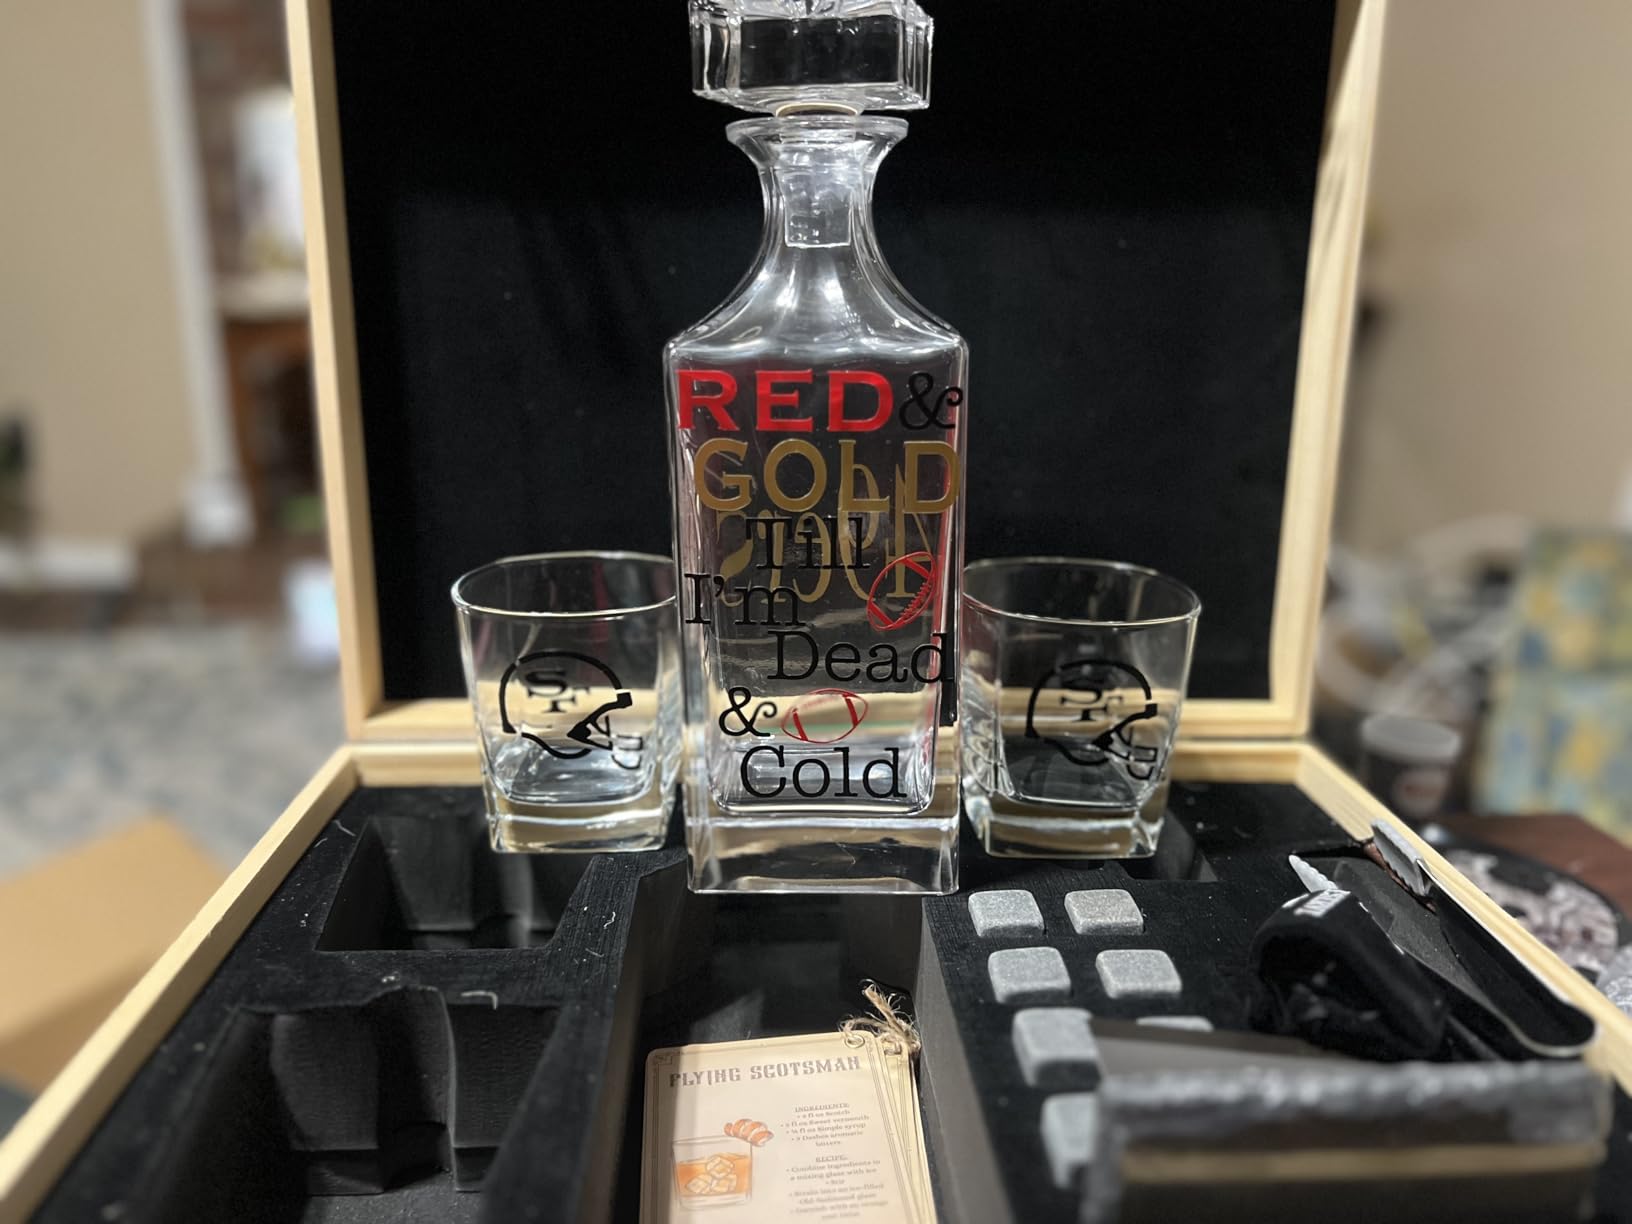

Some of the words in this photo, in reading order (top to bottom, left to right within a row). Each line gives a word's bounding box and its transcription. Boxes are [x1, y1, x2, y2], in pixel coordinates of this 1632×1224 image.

[675, 369, 894, 432] RED
[694, 438, 960, 513] GOLD
[745, 516, 870, 570] Till
[684, 573, 806, 626] I'm
[767, 630, 955, 683] Dead
[718, 686, 777, 737] &
[740, 745, 907, 798] Cold
[669, 1067, 742, 1088] FLYING
[750, 1055, 861, 1081] SCOTSMAN
